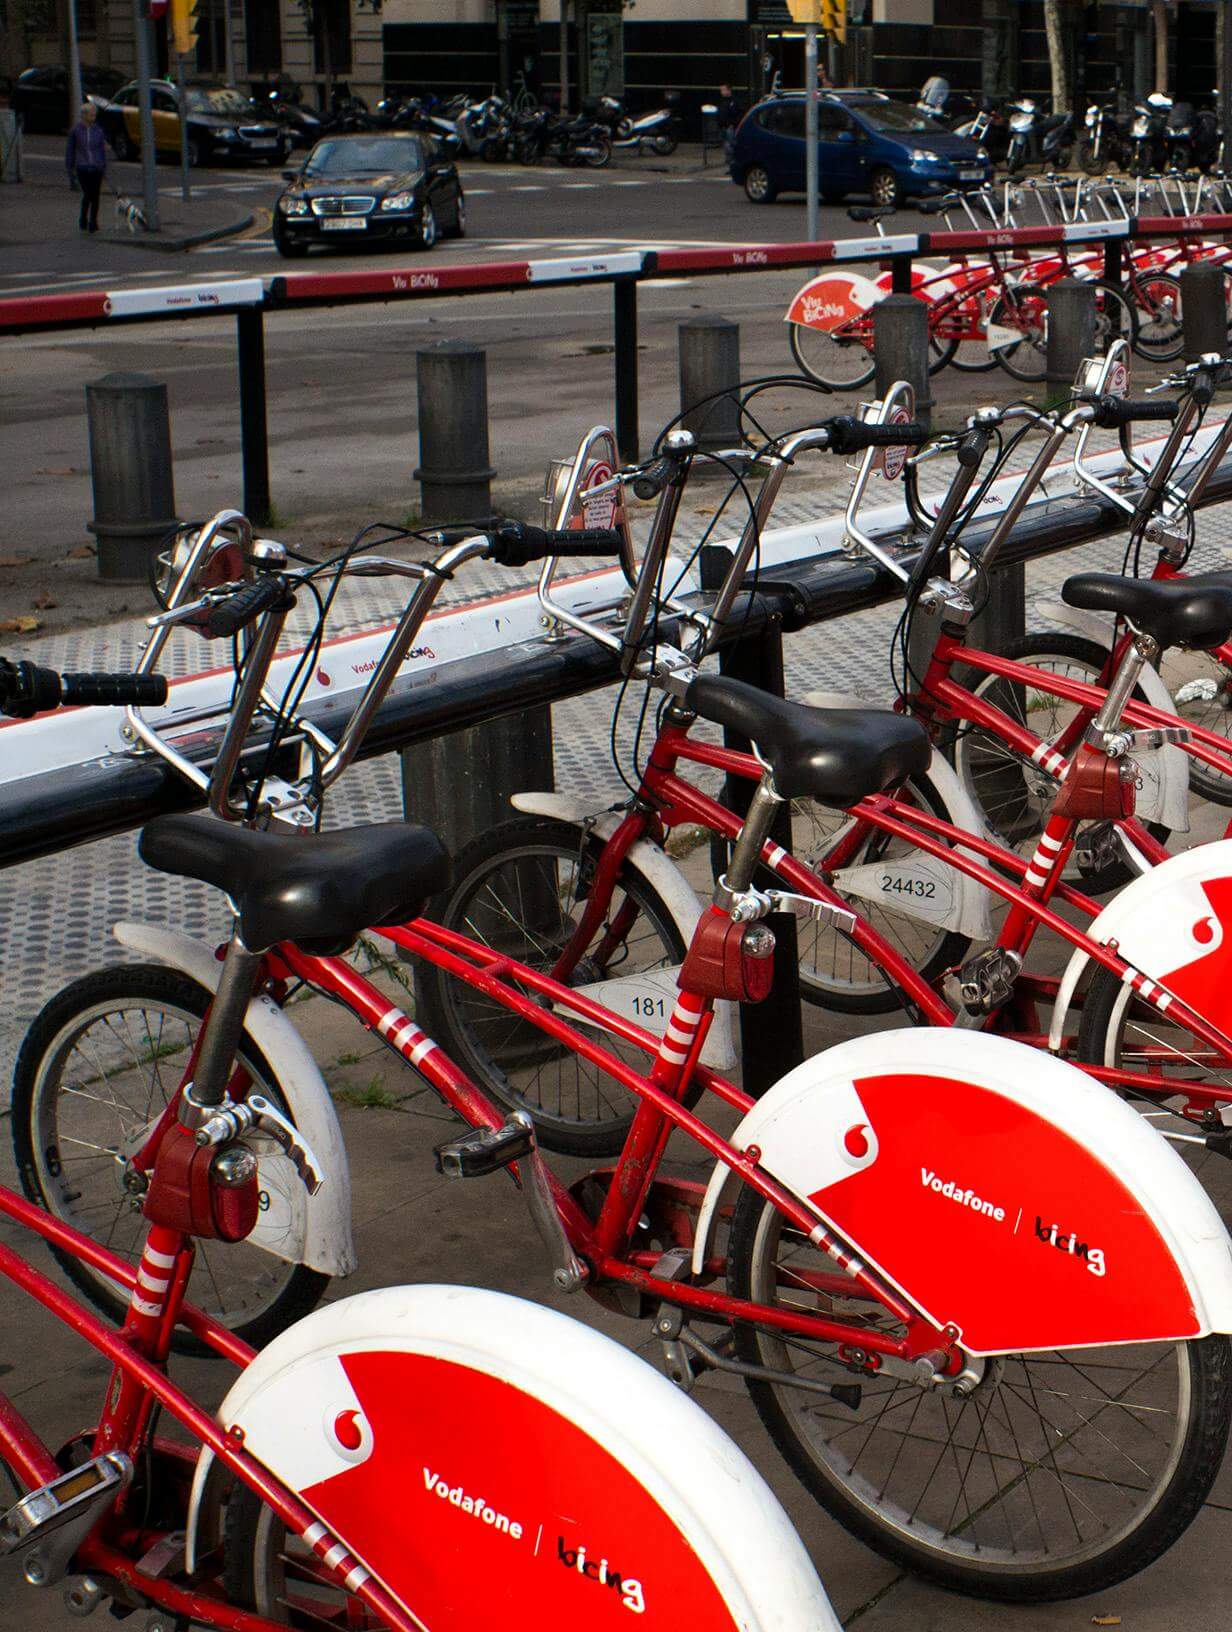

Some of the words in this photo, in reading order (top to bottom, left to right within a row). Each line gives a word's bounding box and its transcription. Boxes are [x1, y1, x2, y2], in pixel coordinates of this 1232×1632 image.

[352, 659, 379, 674] Vodaf
[881, 875, 936, 899] 24432
[632, 996, 664, 1017] 181
[921, 1168, 1005, 1222] Vodafone
[1035, 1215, 1106, 1277] bicing
[423, 1467, 523, 1540] Vodafone
[558, 1535, 645, 1614] bicing
